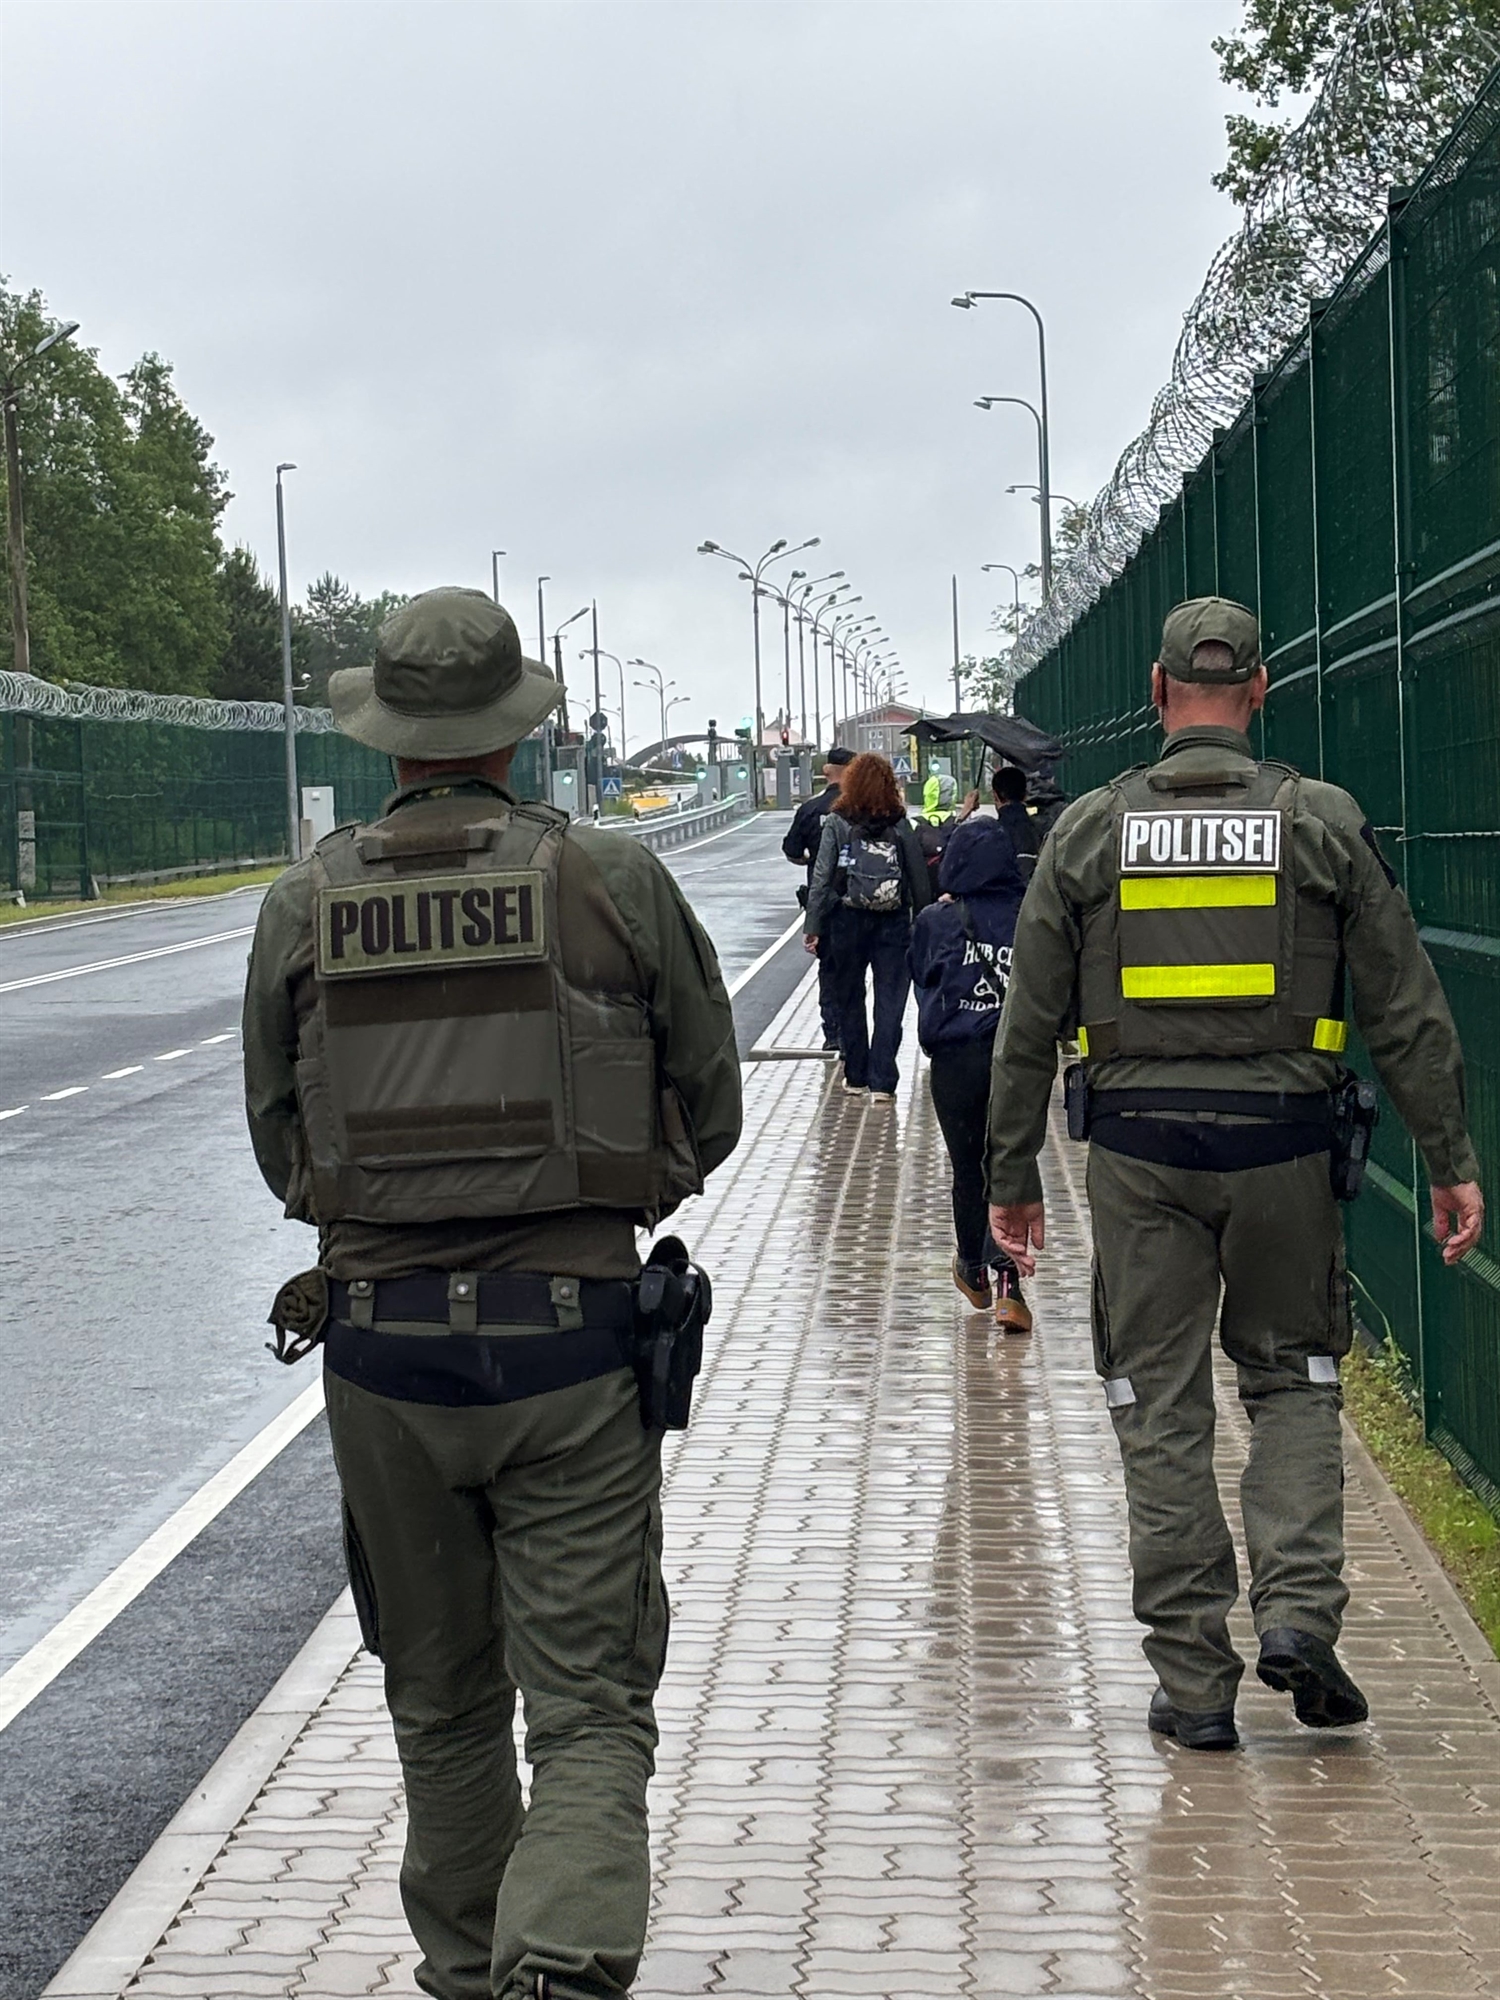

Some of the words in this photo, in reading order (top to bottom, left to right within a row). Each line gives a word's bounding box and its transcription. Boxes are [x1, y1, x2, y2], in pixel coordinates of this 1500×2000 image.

[1127, 817, 1274, 863] POLITSEI
[330, 885, 534, 959] POLITSEI
[962, 940, 994, 966] HUB
